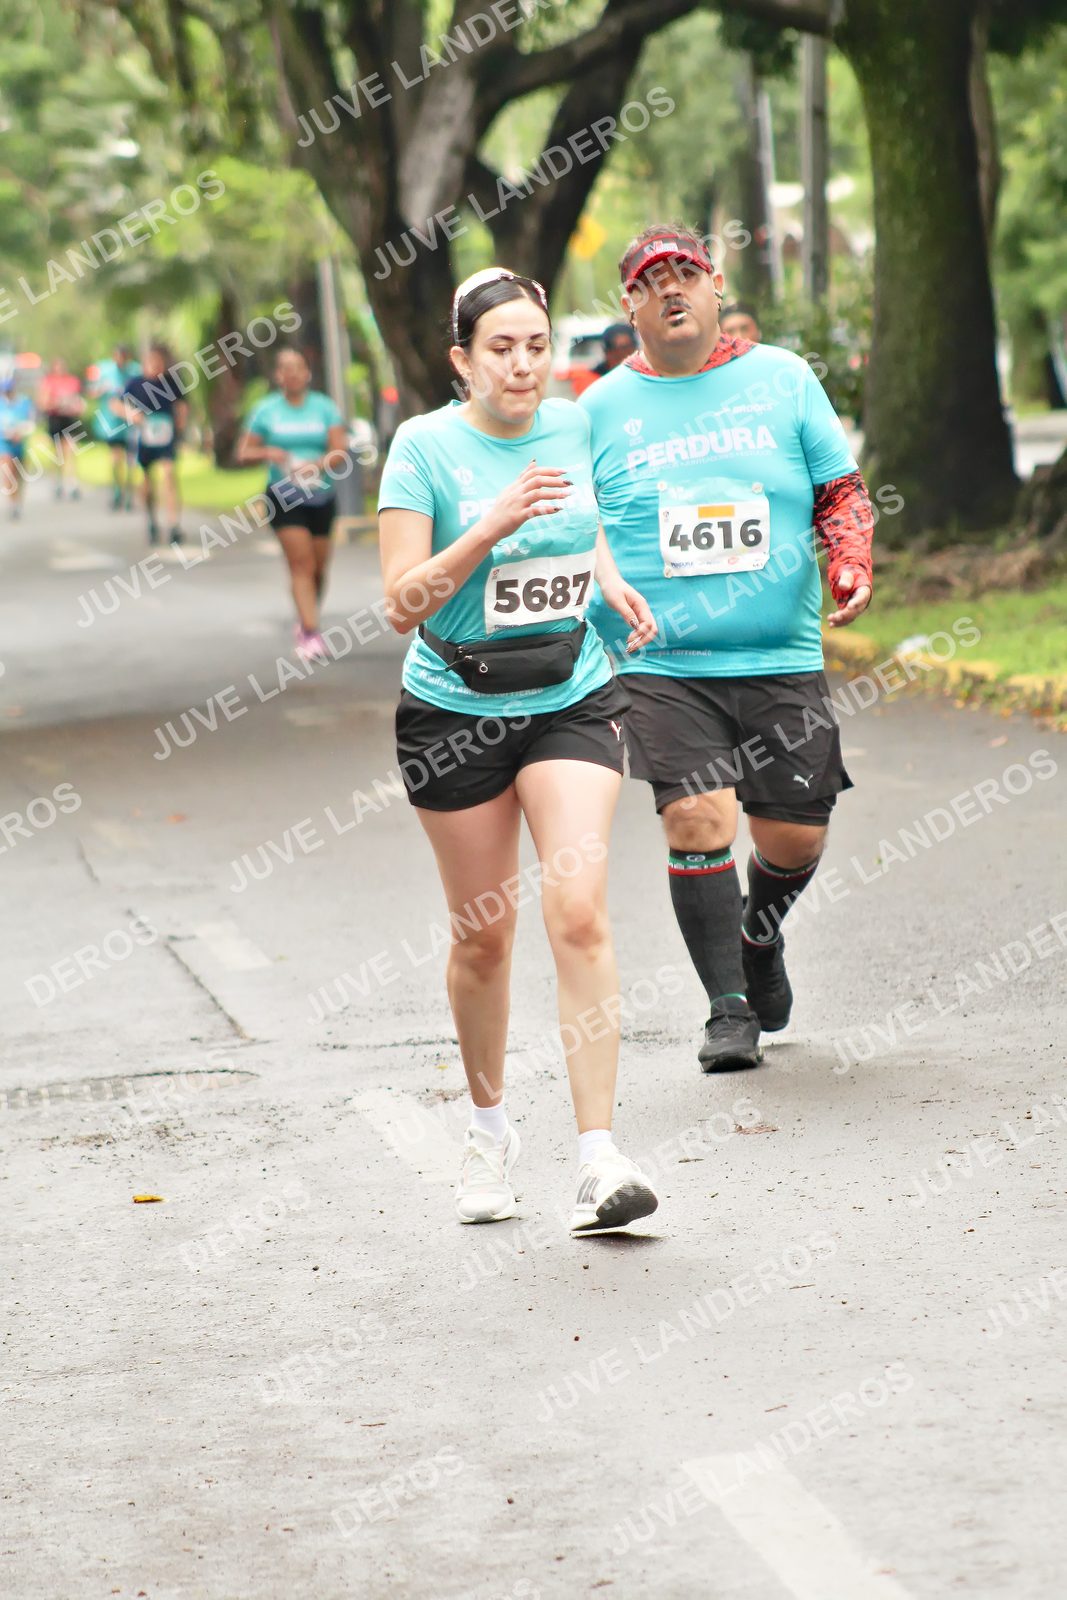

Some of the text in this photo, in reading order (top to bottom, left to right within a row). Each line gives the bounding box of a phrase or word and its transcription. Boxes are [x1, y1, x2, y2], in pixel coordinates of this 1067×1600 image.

[626, 426, 778, 472] PERDURA
[669, 519, 762, 551] 4616
[494, 571, 591, 613] 5687
